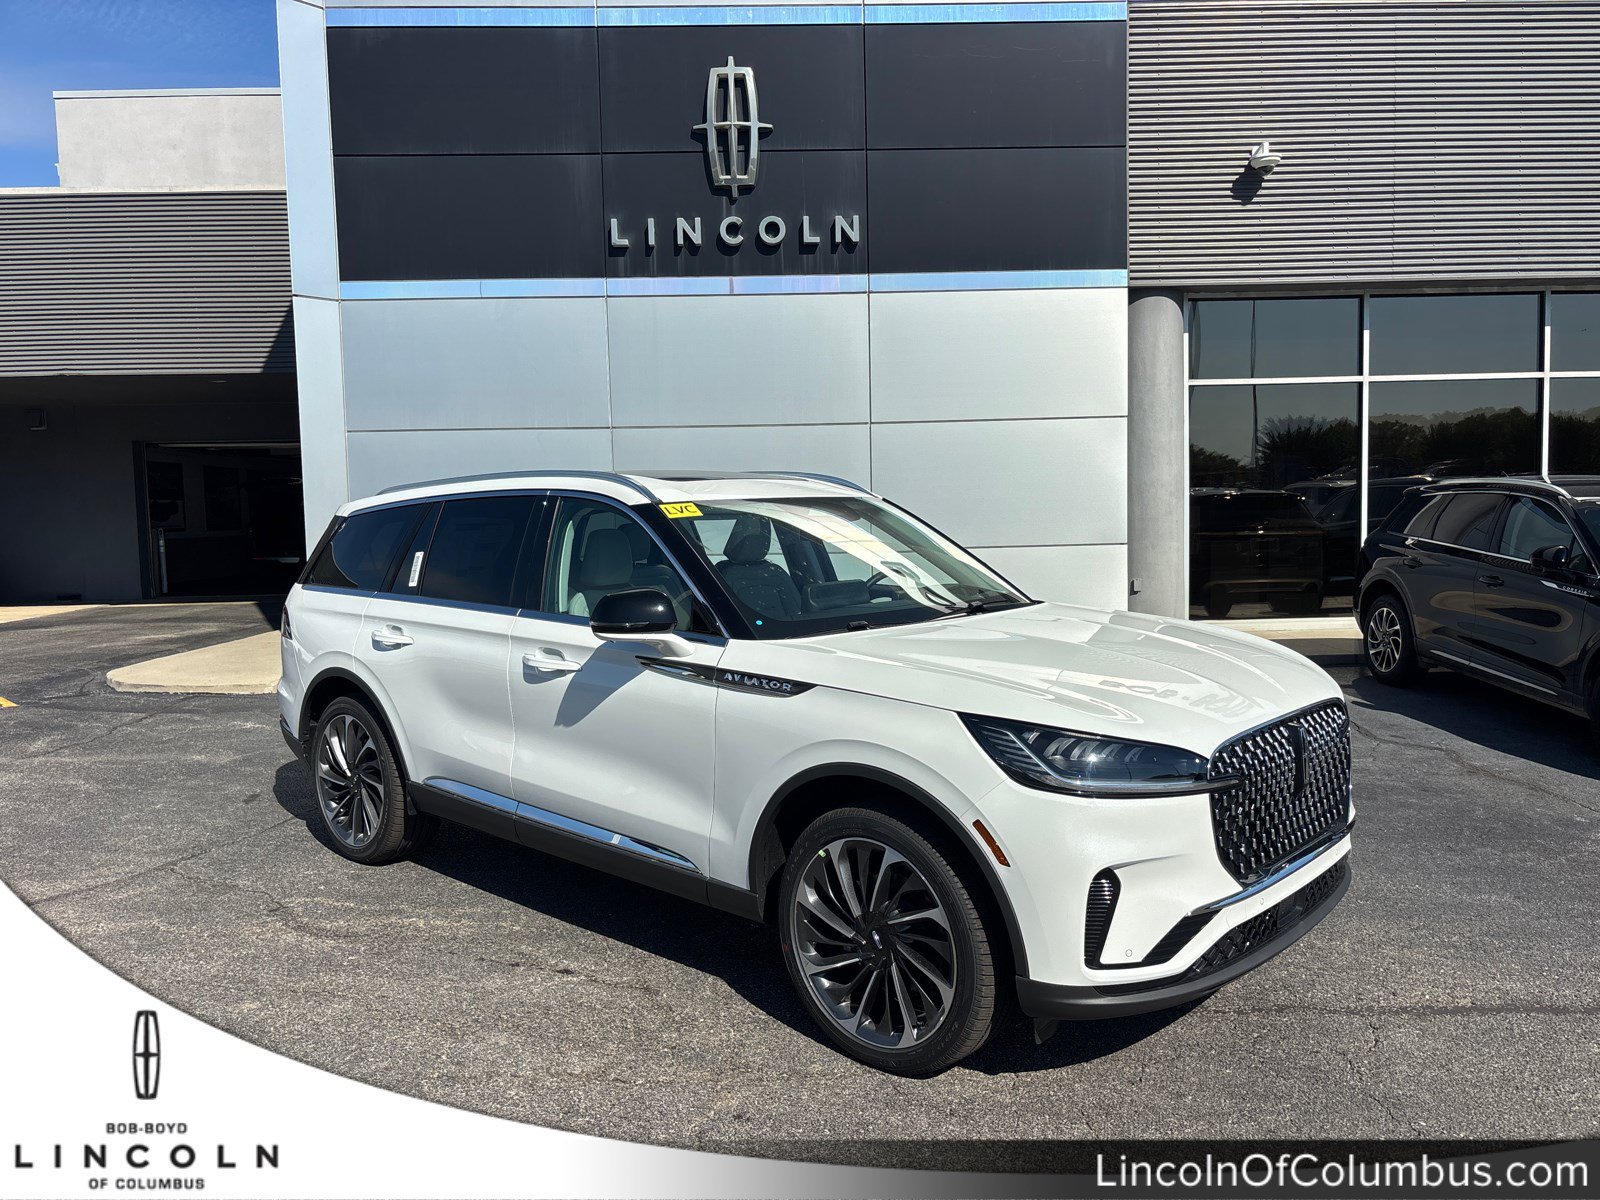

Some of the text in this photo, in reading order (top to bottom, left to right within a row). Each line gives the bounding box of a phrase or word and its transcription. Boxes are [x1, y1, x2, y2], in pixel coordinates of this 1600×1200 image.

[610, 215, 860, 247] LINCOLN
[663, 504, 698, 515] LVC
[723, 671, 793, 692] AVIATOR
